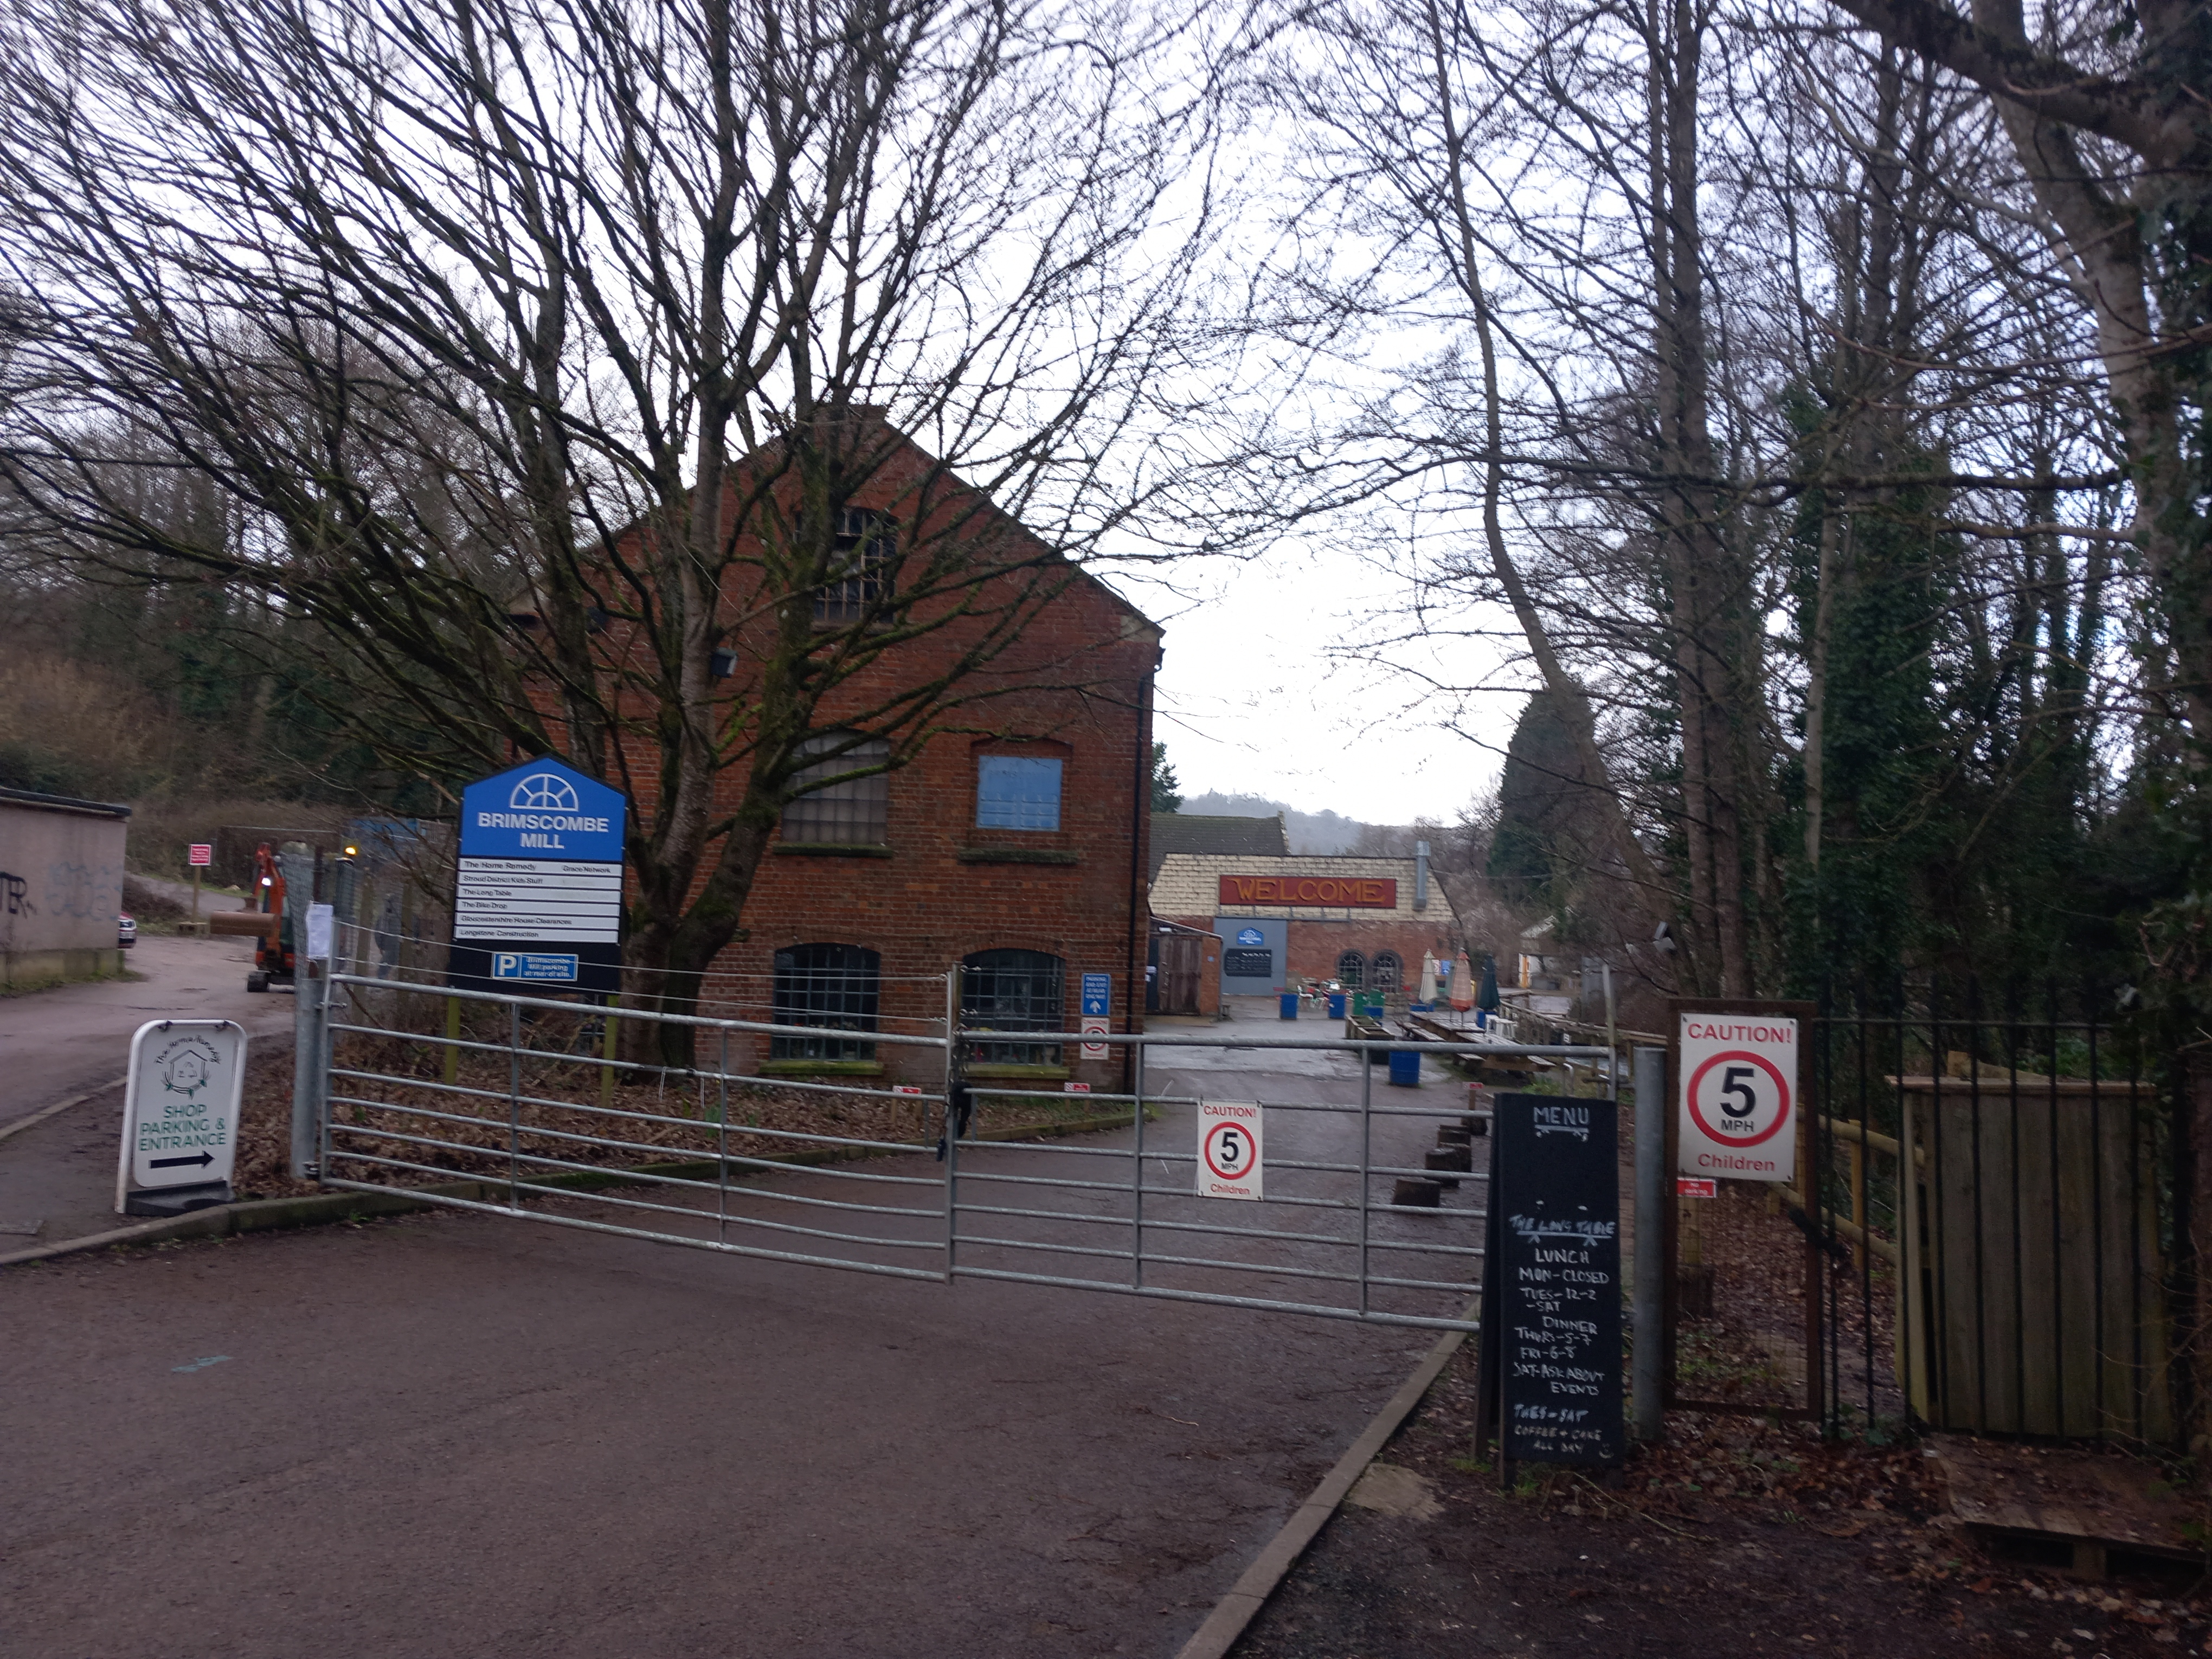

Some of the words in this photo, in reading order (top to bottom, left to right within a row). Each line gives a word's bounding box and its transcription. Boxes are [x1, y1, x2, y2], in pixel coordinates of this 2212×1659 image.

[477, 812, 609, 833] BRIMSCOMBE
[520, 832, 565, 849] MILL
[506, 862, 536, 871] Remedy
[1227, 877, 1386, 903] WELCOME
[1687, 1023, 1792, 1044] CAUTION!
[1720, 1066, 1756, 1118] 5
[163, 1104, 207, 1118] SHOP
[1203, 1105, 1257, 1118] CAUTION!
[1533, 1106, 1590, 1126] MENU
[139, 1118, 210, 1136] PARKING
[215, 1117, 226, 1130] &
[1720, 1119, 1755, 1132] MPH
[138, 1132, 227, 1151] ENTRANCE
[1220, 1131, 1239, 1162] 5
[1698, 1153, 1776, 1172] Children
[1210, 1184, 1251, 1195] Children
[1534, 1248, 1590, 1264] LUNCH
[1541, 1315, 1598, 1335] DINNER
